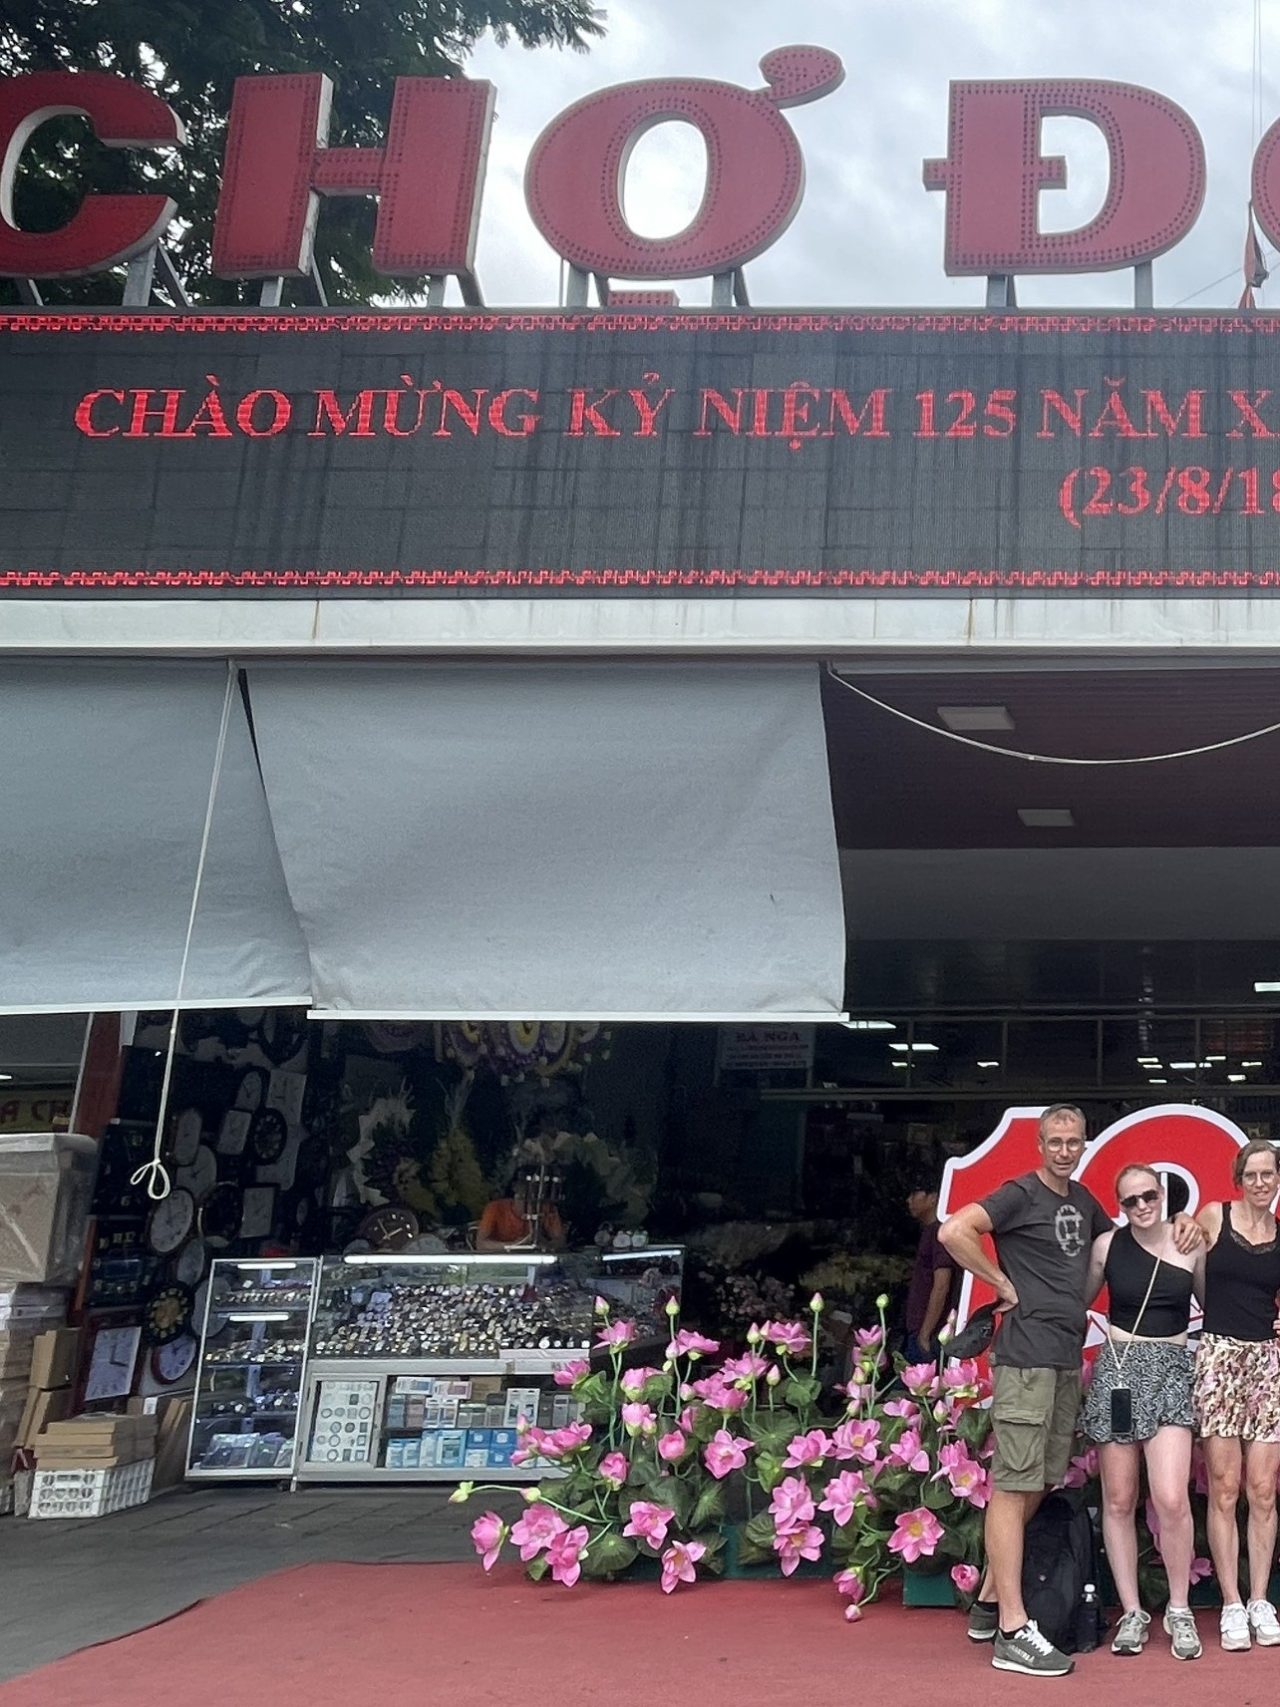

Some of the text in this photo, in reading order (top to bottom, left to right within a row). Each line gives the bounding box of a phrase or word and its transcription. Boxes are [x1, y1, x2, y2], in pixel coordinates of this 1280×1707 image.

[0, 45, 844, 282] CHỢ
[74, 375, 293, 439] CHÀO
[309, 373, 540, 439] MỪNG
[565, 371, 676, 438] KỶ
[693, 380, 891, 451] NIỆM
[914, 389, 1018, 440] 125
[1038, 375, 1206, 440] NĂM
